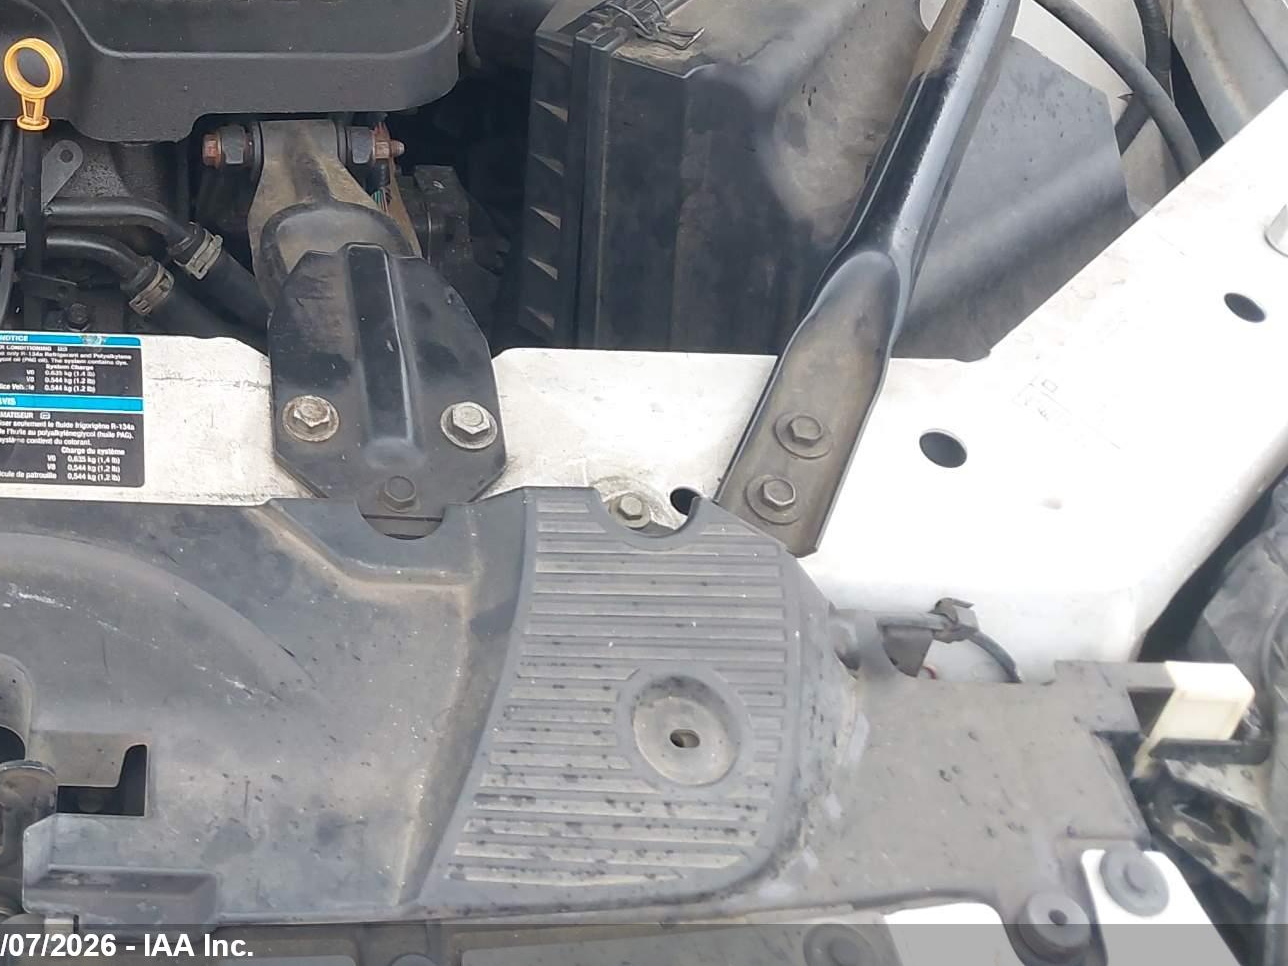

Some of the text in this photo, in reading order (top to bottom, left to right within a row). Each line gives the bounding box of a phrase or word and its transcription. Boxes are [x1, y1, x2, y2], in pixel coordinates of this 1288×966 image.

[55, 421, 73, 429] fluide
[111, 423, 135, 431] R-134a
[26, 437, 53, 445] contient
[61, 446, 85, 454] Charge
[97, 447, 125, 455] système
[87, 455, 96, 464] kg
[87, 465, 96, 473] kg
[26, 471, 57, 480] patrouille
[87, 473, 96, 482] kg
